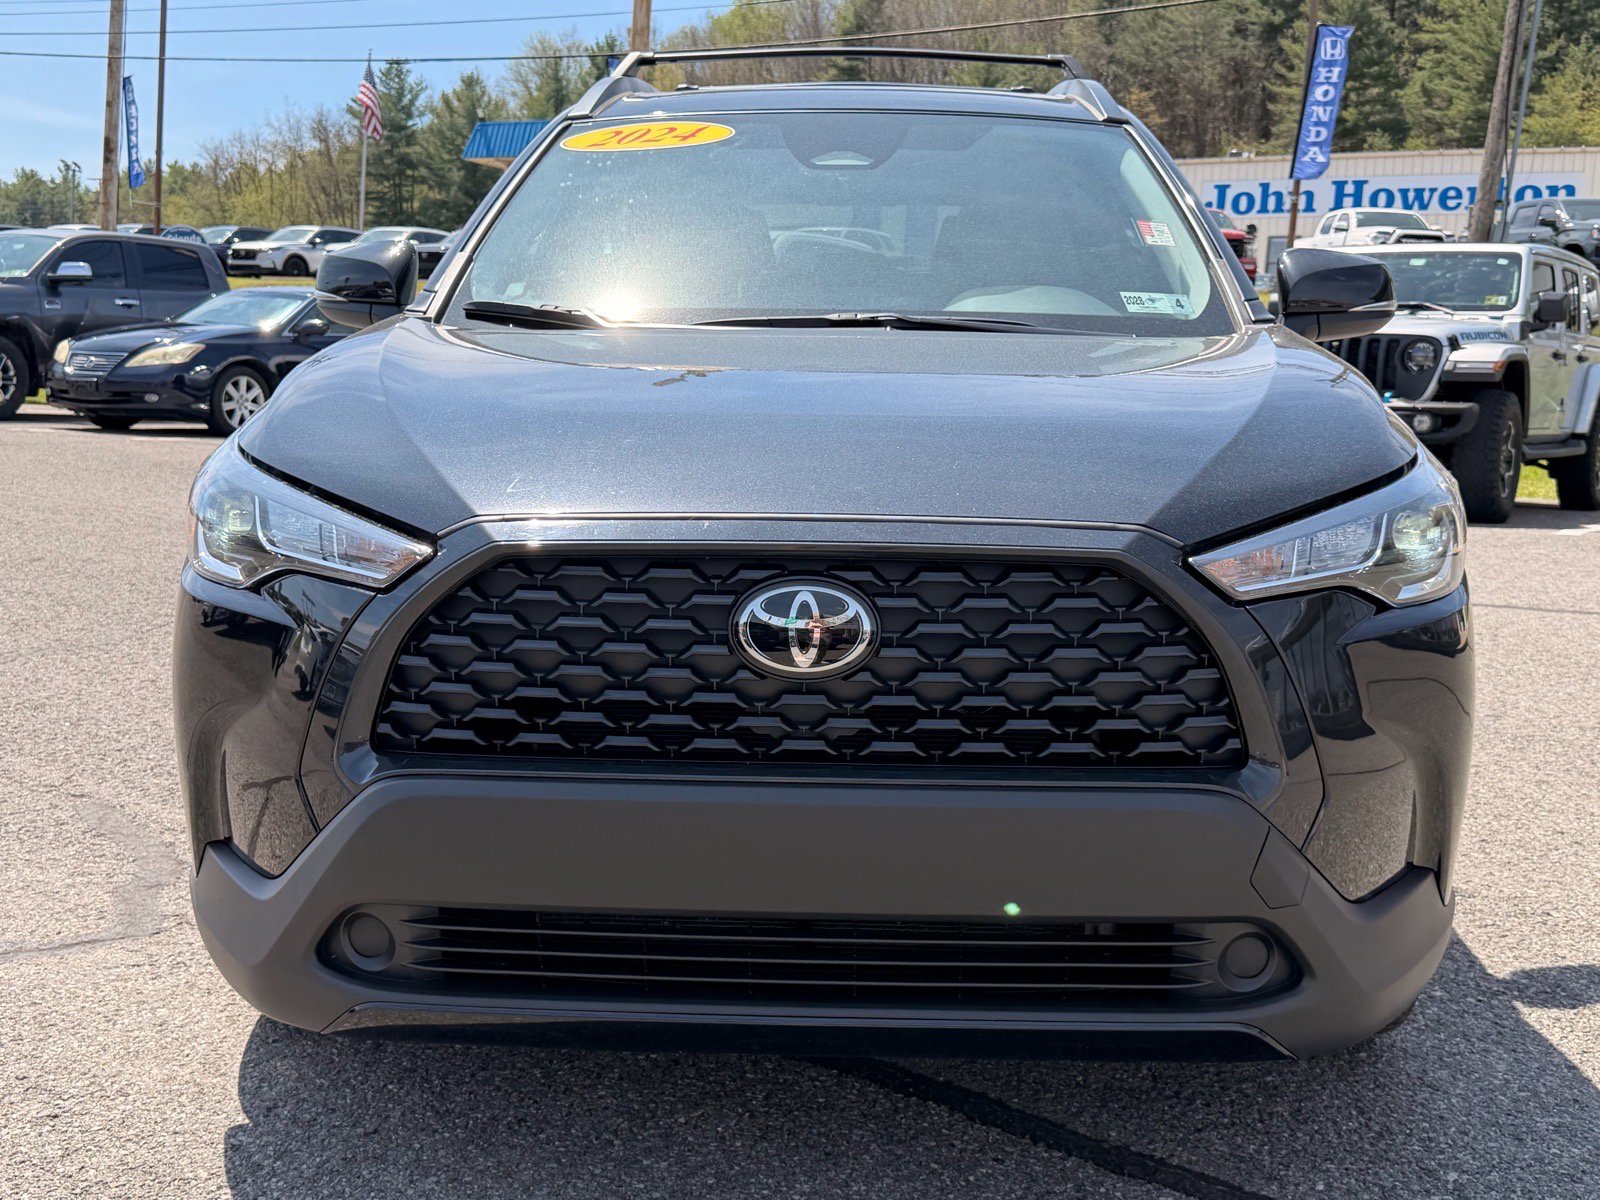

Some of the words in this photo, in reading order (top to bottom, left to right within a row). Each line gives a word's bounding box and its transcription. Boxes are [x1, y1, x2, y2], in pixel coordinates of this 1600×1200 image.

[1300, 67, 1342, 162] HONDA
[587, 125, 711, 148] 2024
[1204, 182, 1317, 215] John
[1175, 298, 1185, 310] 4
[1459, 330, 1508, 342] RUBICON
